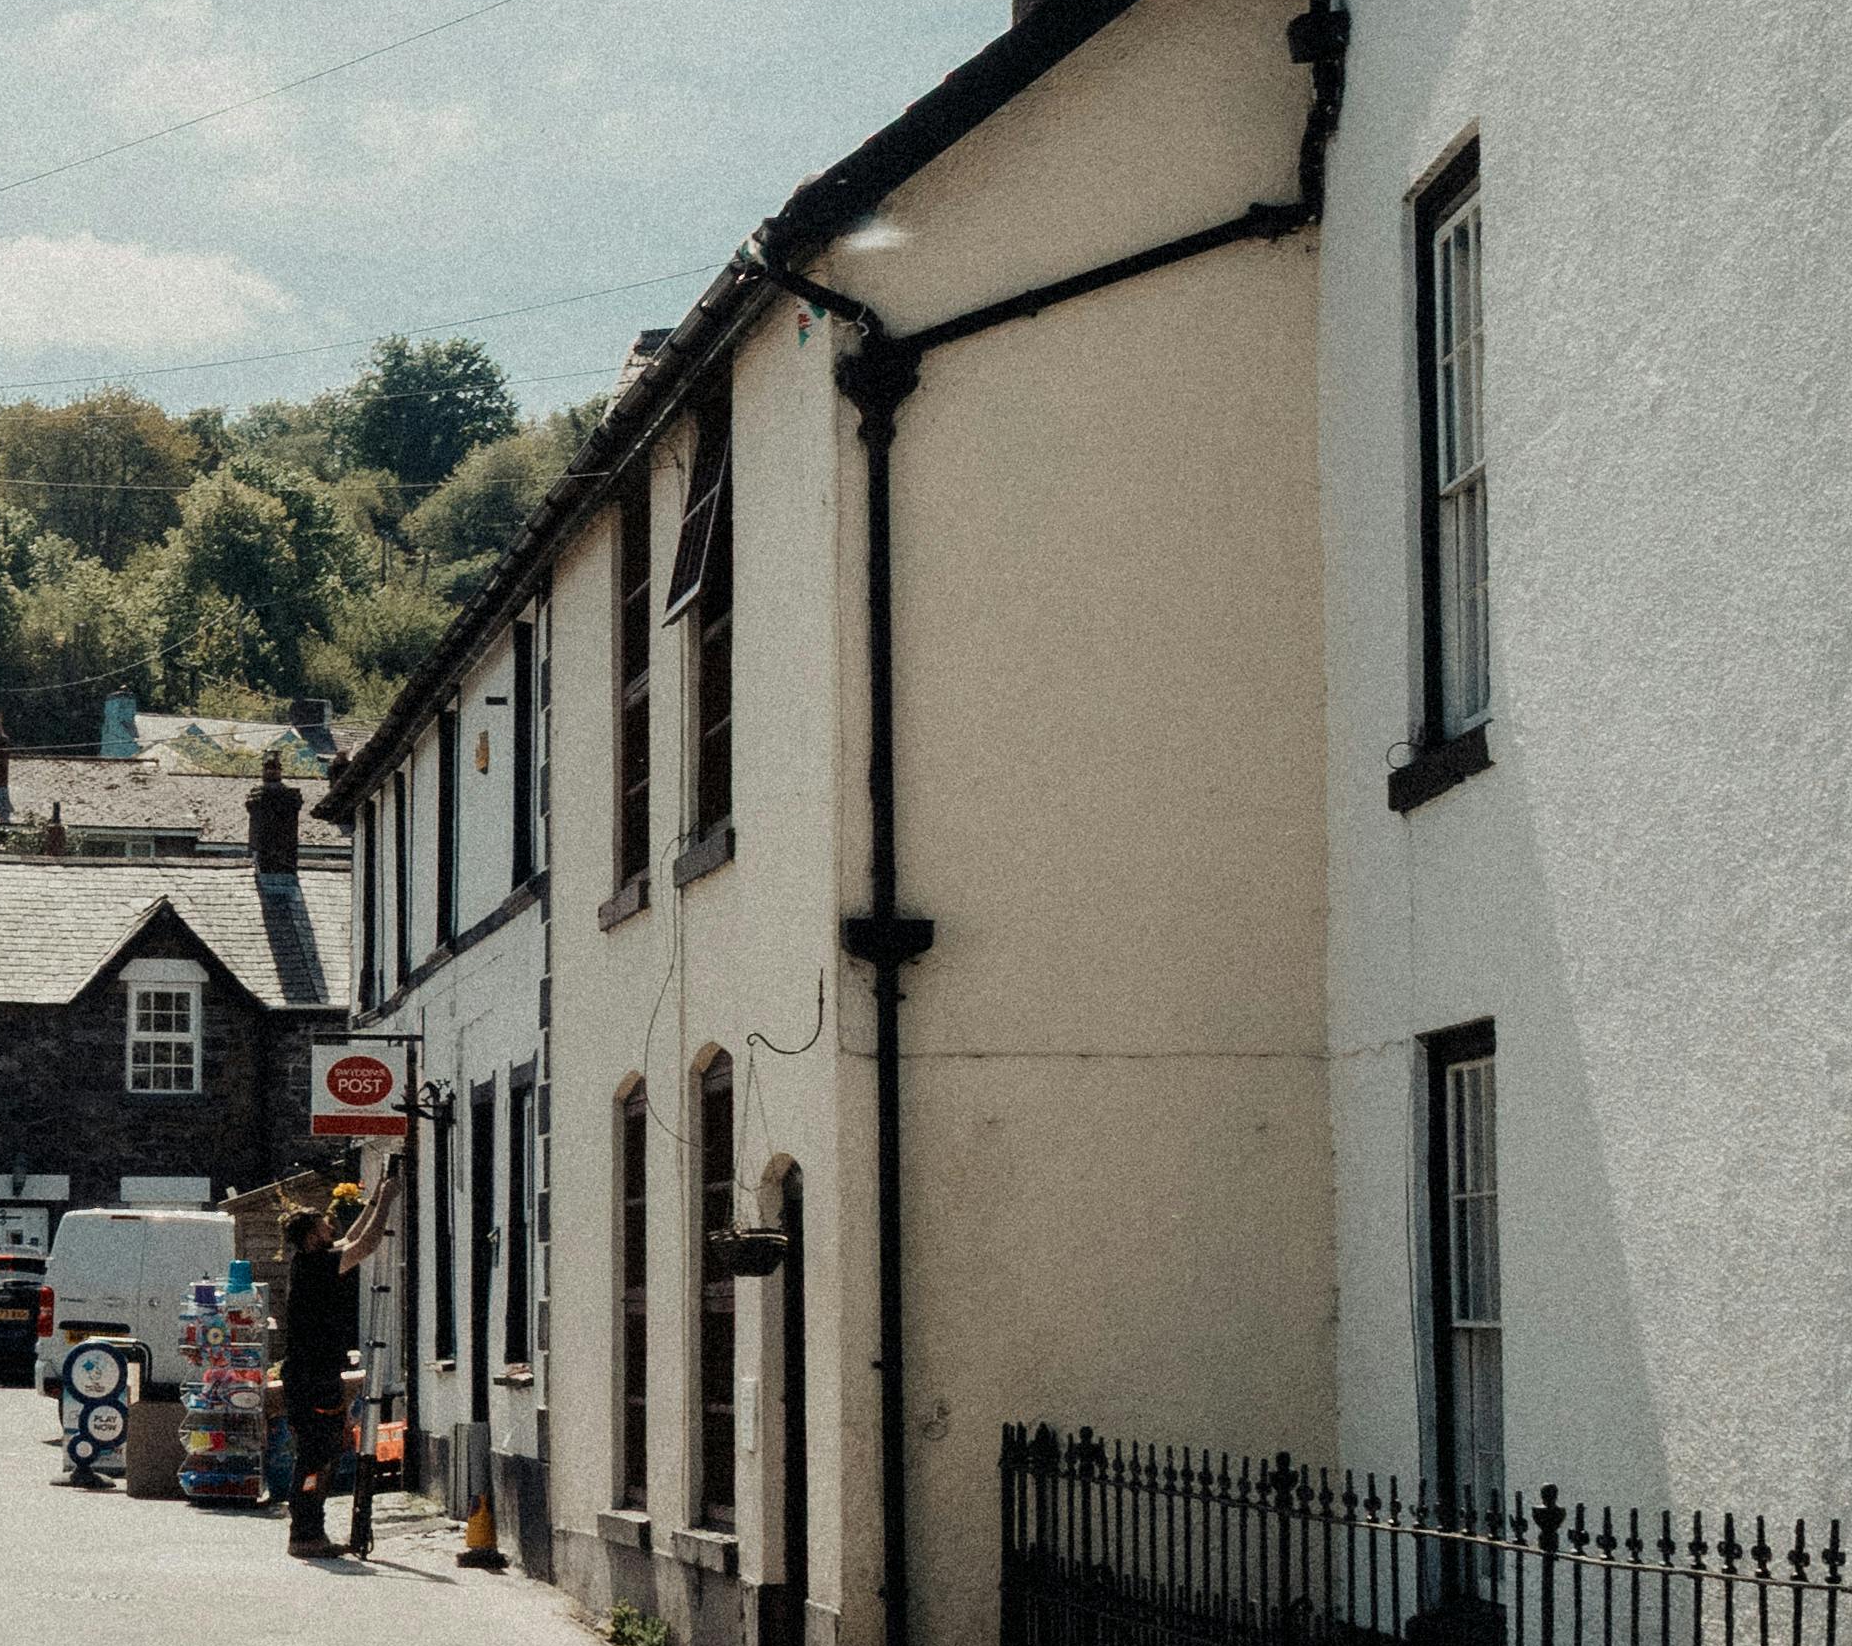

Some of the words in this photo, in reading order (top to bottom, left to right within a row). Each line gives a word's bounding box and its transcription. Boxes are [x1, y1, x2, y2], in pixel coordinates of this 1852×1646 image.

[338, 1078, 383, 1093] POST
[93, 1415, 118, 1424] PLAY
[93, 1424, 117, 1432] NOW
